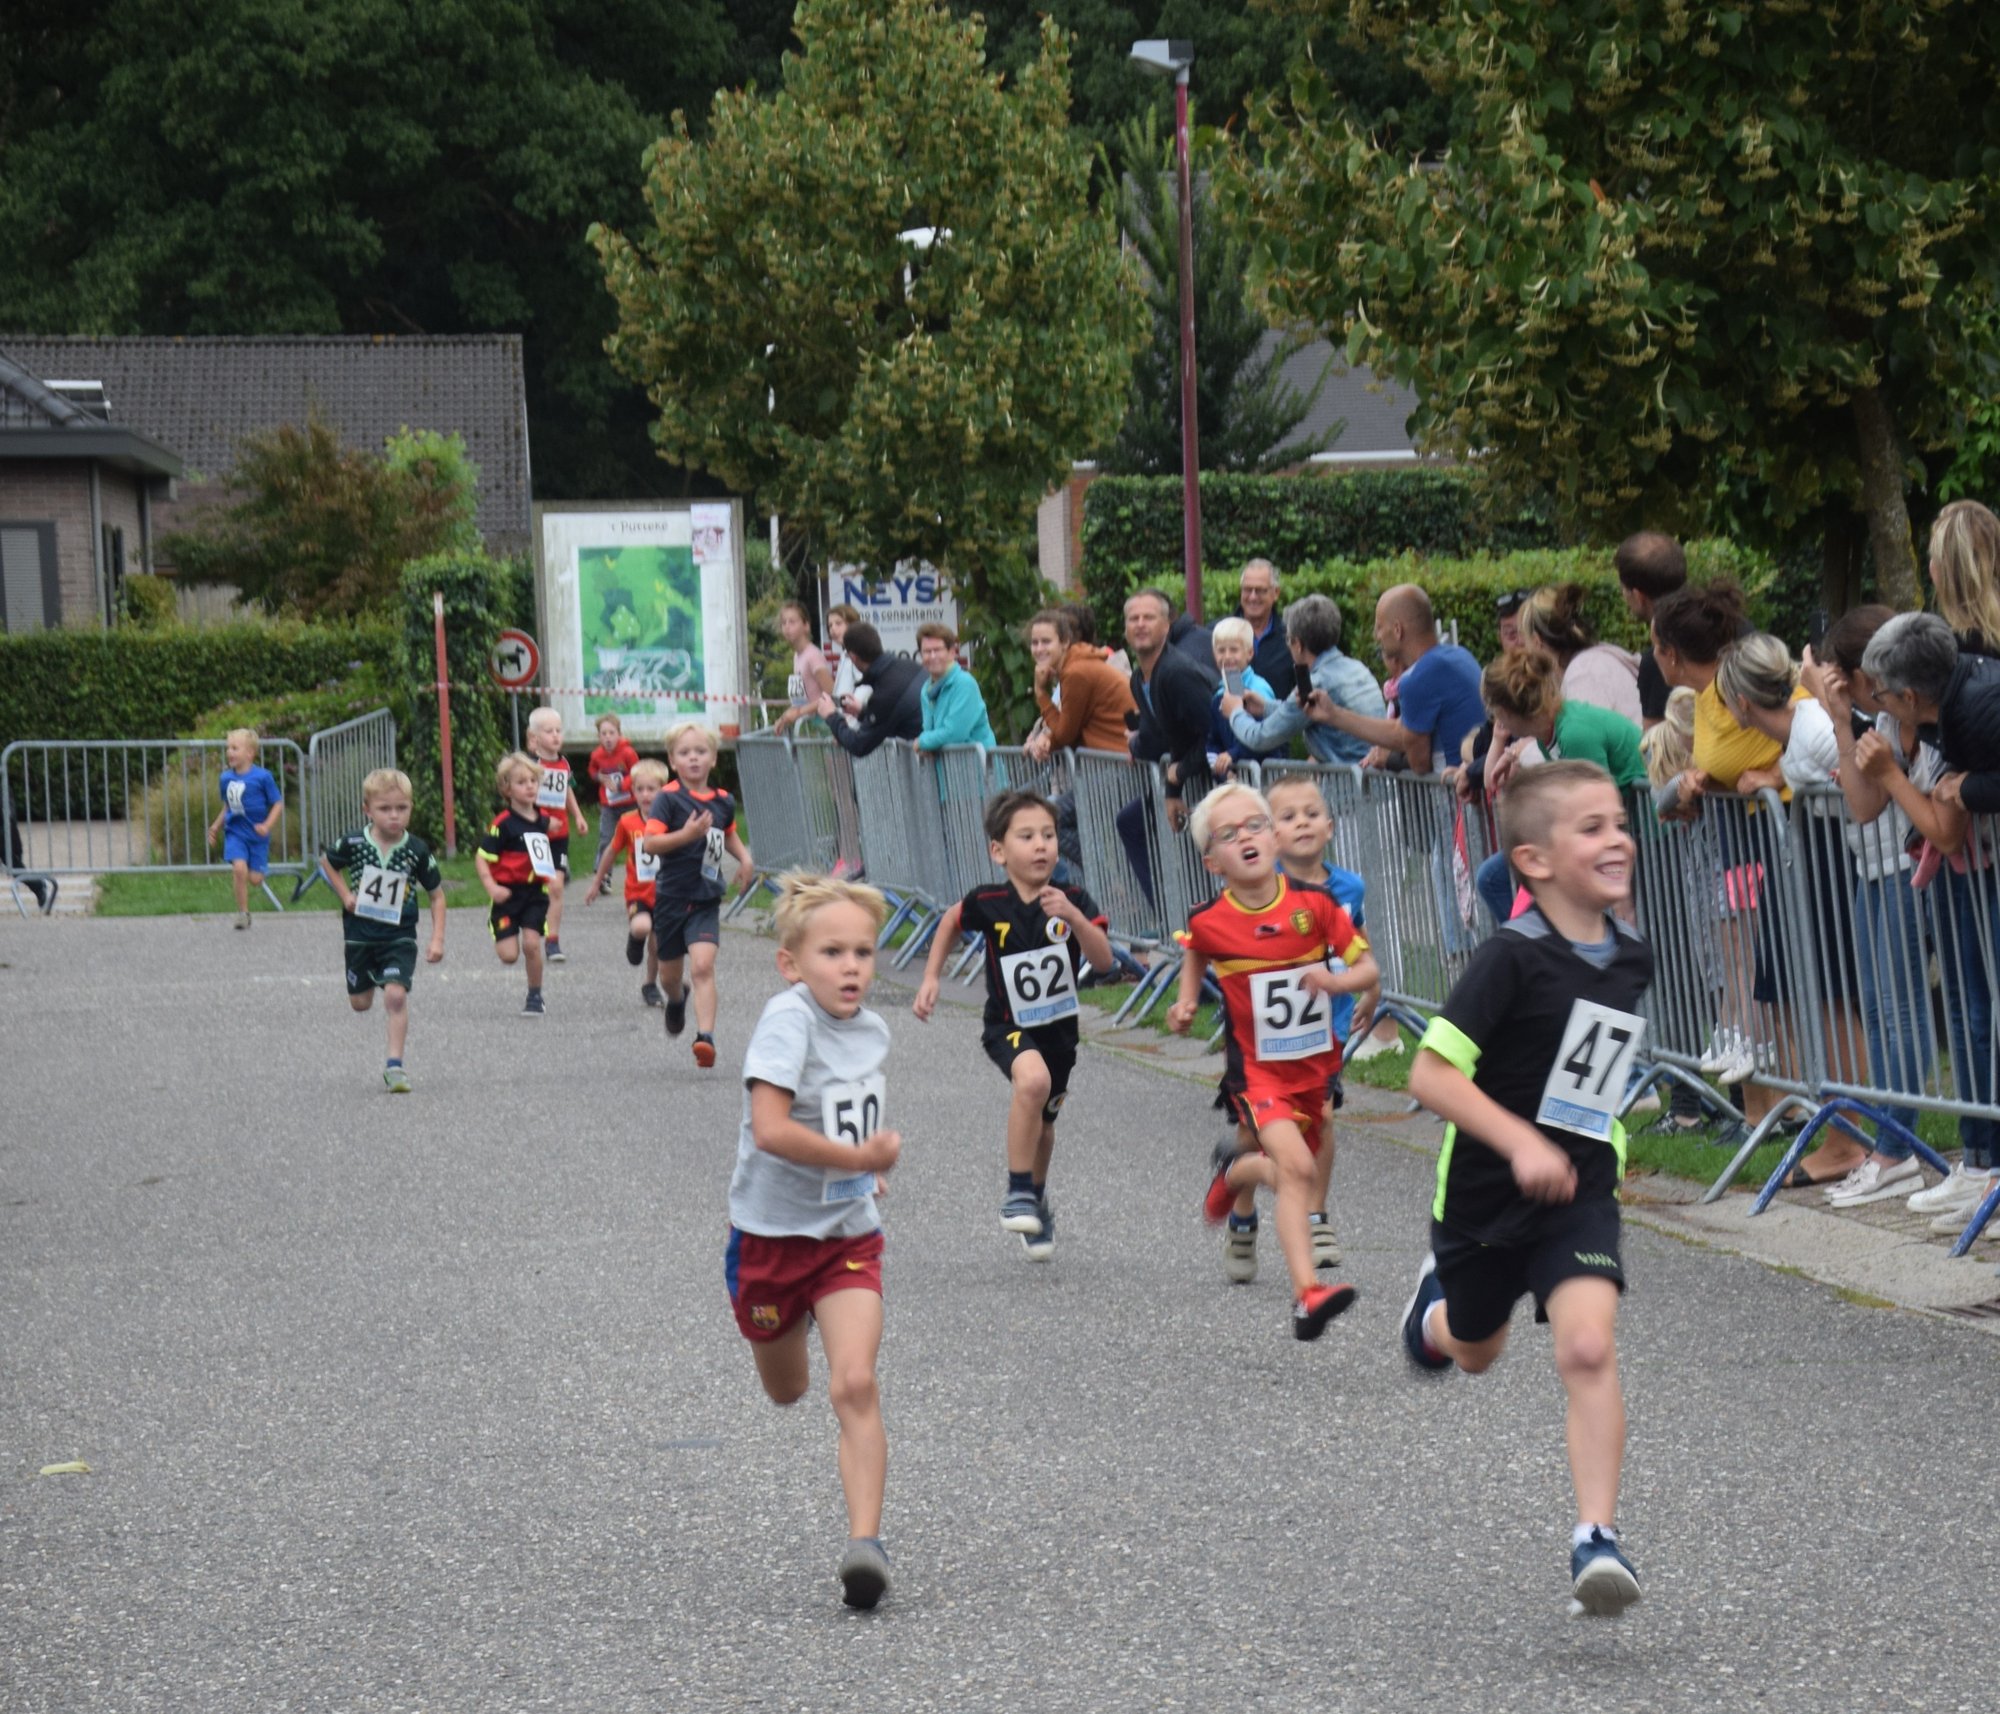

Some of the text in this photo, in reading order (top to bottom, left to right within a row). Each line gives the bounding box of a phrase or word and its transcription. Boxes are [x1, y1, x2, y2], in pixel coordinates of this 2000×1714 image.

[843, 575, 936, 606] NEYS
[881, 607, 944, 621] consultancy
[543, 771, 565, 793] 48
[531, 838, 551, 862] 67
[707, 831, 723, 862] 43
[365, 874, 399, 905] 41
[994, 922, 1011, 949] 7
[1013, 954, 1069, 1002] 62
[1265, 976, 1323, 1030] 52
[1006, 1031, 1022, 1049] 7
[1562, 1020, 1632, 1095] 47
[836, 1093, 878, 1147] 50
